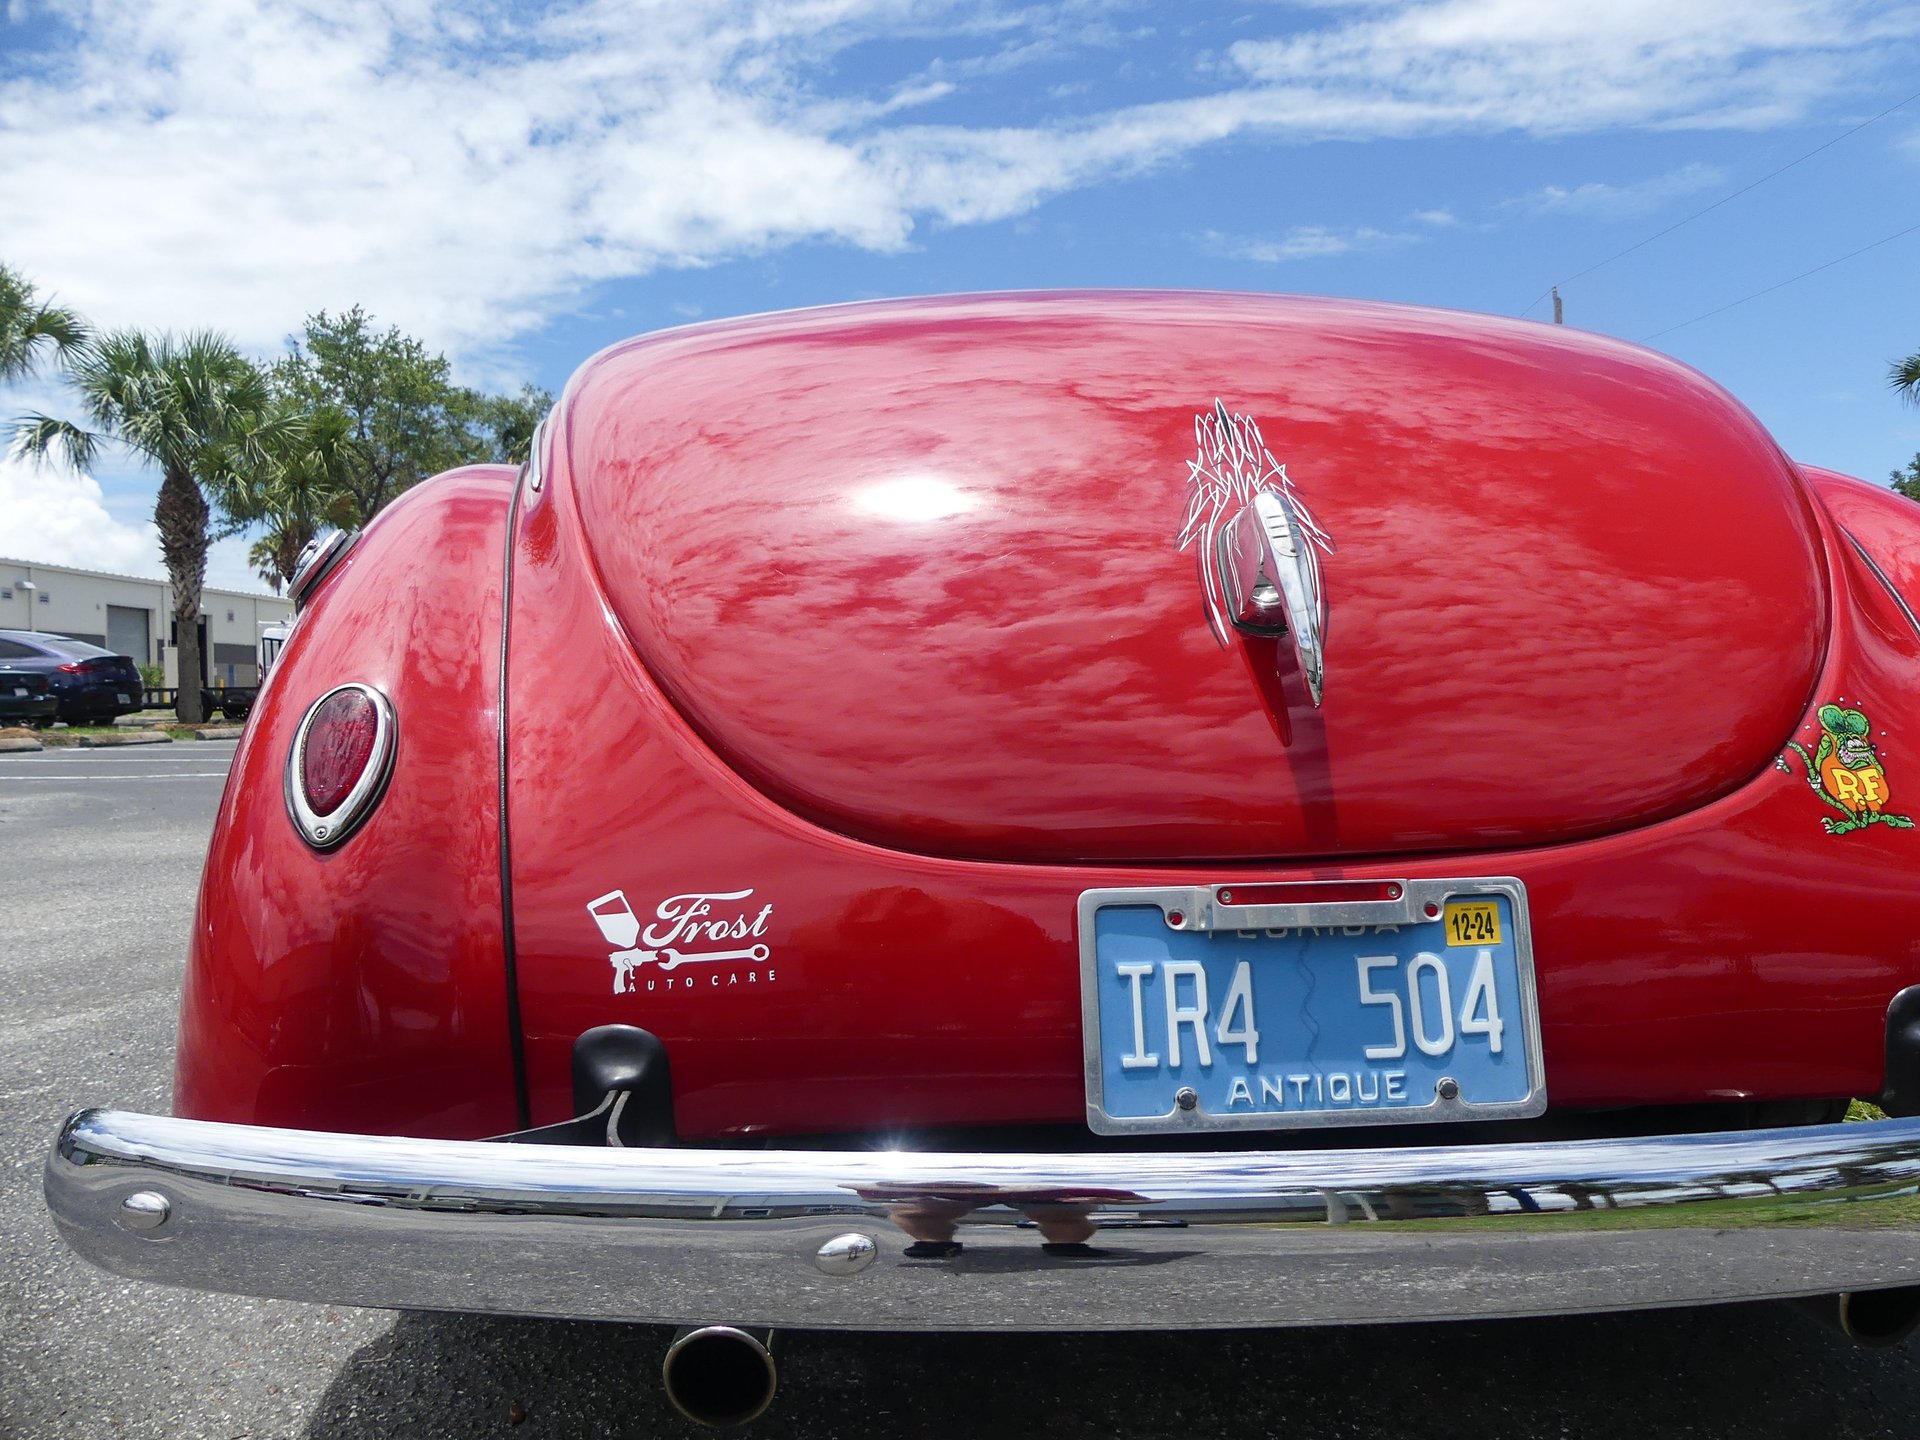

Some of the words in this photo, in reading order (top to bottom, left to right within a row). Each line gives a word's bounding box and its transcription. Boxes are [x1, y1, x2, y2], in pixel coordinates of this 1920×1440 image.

[642, 888, 773, 947] Frost
[1452, 911, 1495, 941] 12-24
[628, 977, 694, 993] AUTO
[711, 970, 776, 986] CARE
[1117, 960, 1260, 1068] IR4
[1357, 951, 1503, 1060] 504
[1229, 1070, 1407, 1106] ANTIQUE
